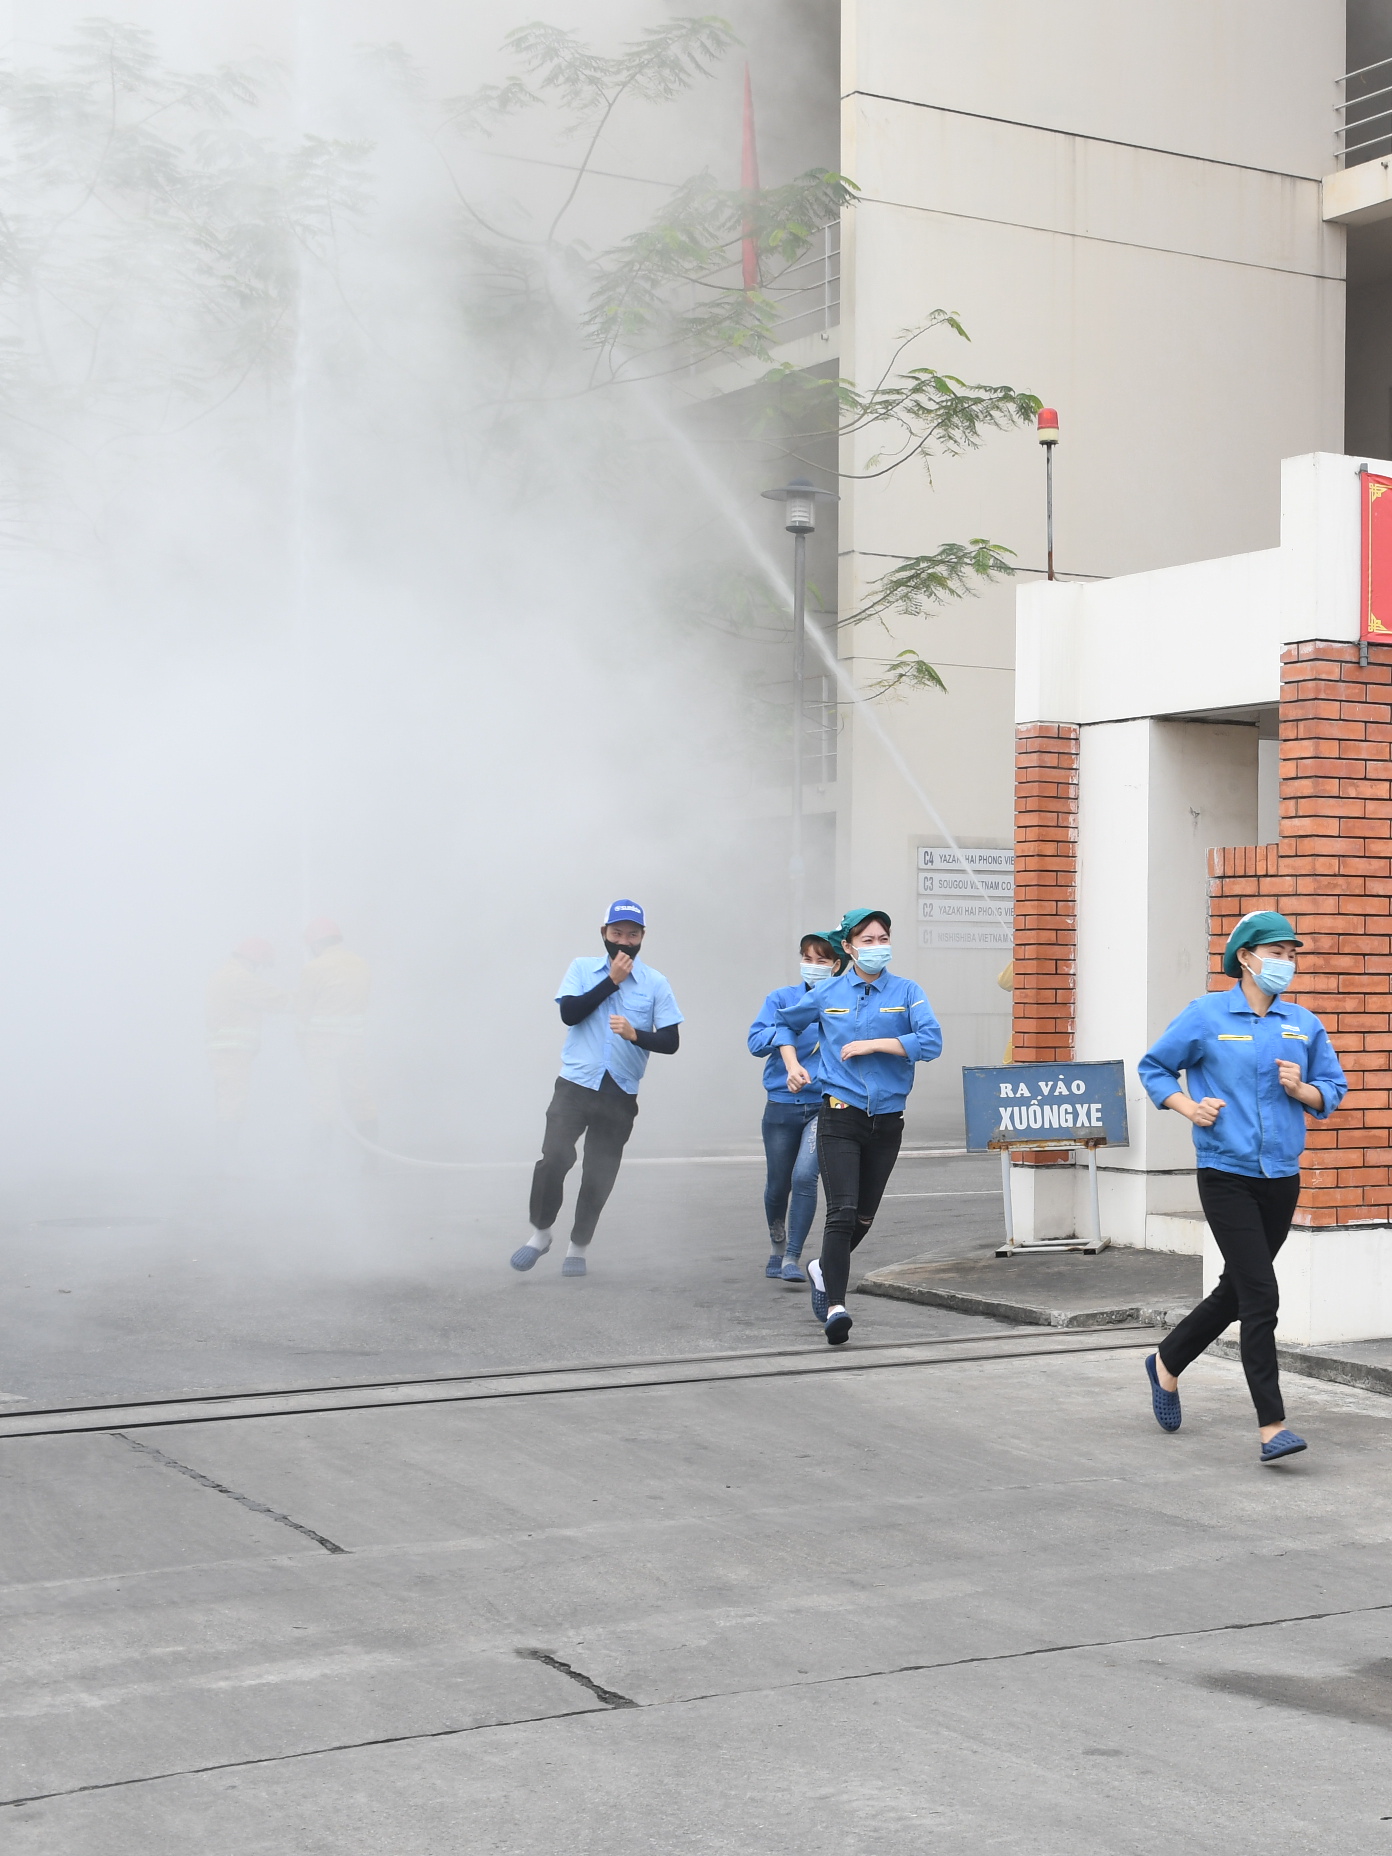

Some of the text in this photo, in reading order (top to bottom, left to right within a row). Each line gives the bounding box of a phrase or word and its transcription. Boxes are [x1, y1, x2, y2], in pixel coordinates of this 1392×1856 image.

[923, 850, 934, 866] C4
[939, 853, 962, 864] YAZA
[965, 854, 977, 865] HAI
[978, 855, 1003, 865] PHONG
[923, 876, 934, 892] C3
[938, 879, 968, 890] SOUGOU
[922, 902, 934, 918] C2
[938, 905, 963, 916] YAZAKI
[964, 906, 977, 916] HAI
[923, 929, 933, 944] C1
[977, 933, 1008, 943] VIETNAM
[1000, 1074, 1086, 1098] RA VÀO
[999, 1096, 1103, 1131] XUỐNG XE
